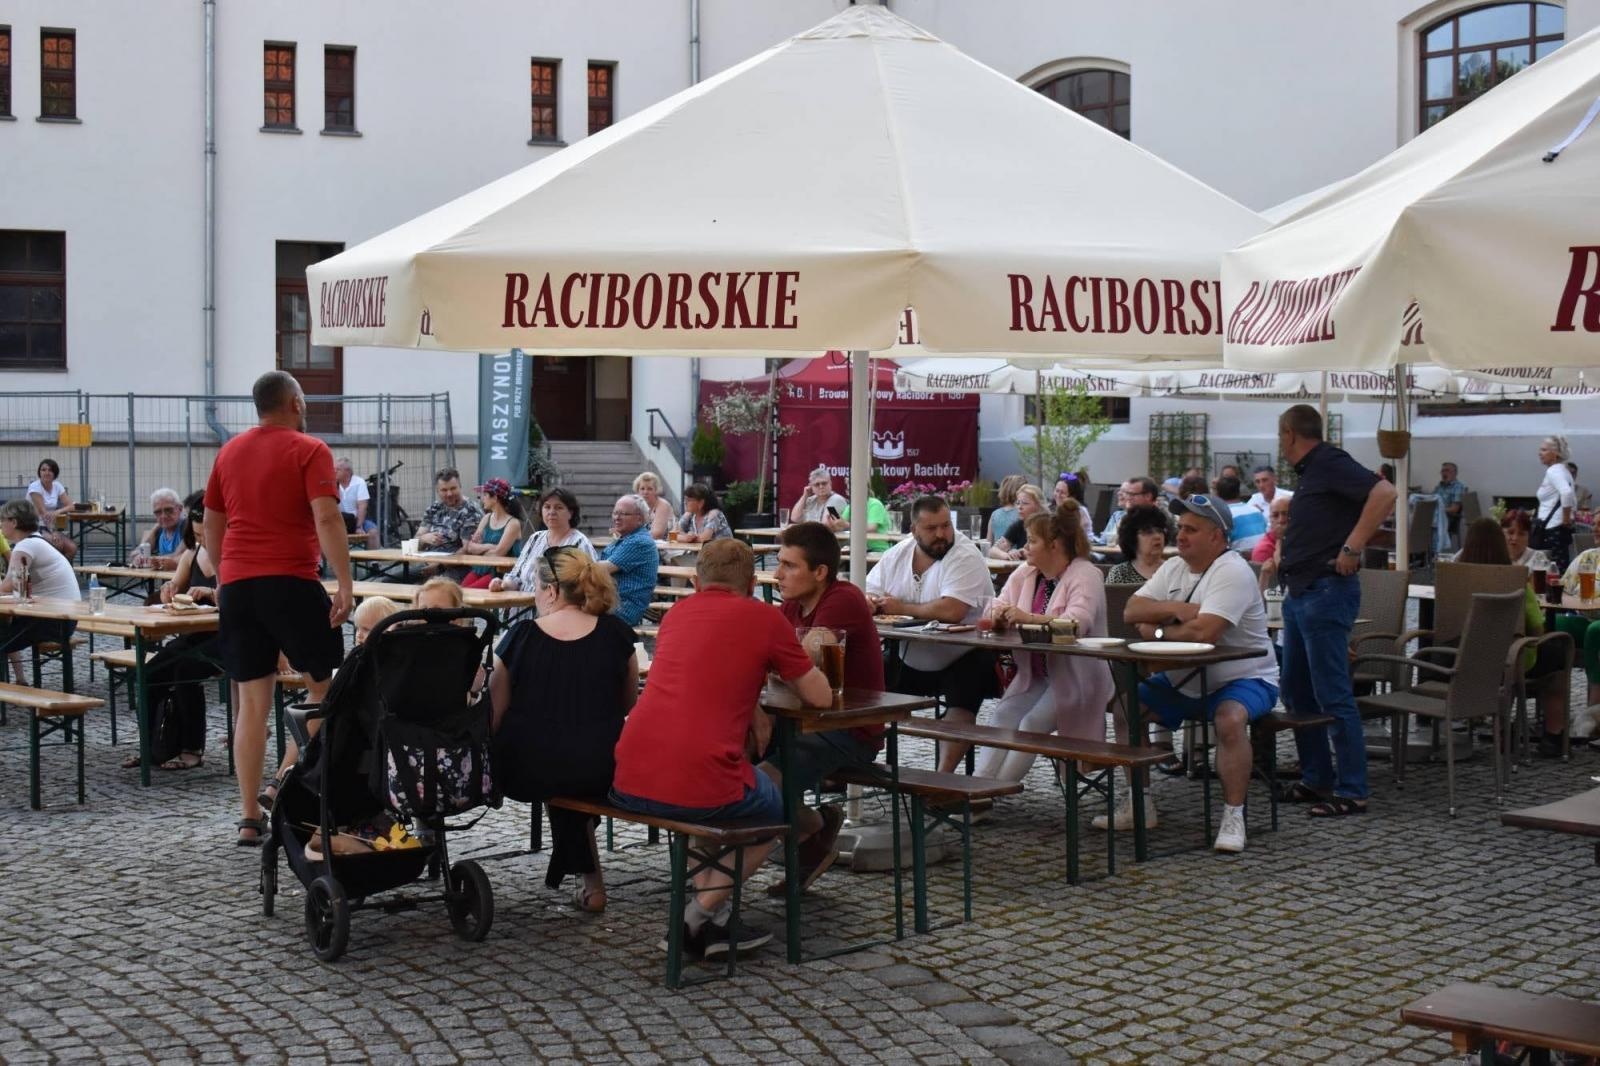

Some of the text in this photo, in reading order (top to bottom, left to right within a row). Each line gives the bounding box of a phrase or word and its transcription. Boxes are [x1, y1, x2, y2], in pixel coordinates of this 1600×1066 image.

[320, 275, 389, 329] RACIBORSKIE
[501, 271, 801, 330] RACIBORSKIE
[926, 373, 992, 389] RACIBORSKIE
[1199, 373, 1277, 389] RACIBORSKIE
[1330, 373, 1418, 390] RACIBORSIE
[819, 463, 850, 477] Browa
[914, 462, 960, 477] Racibórz
